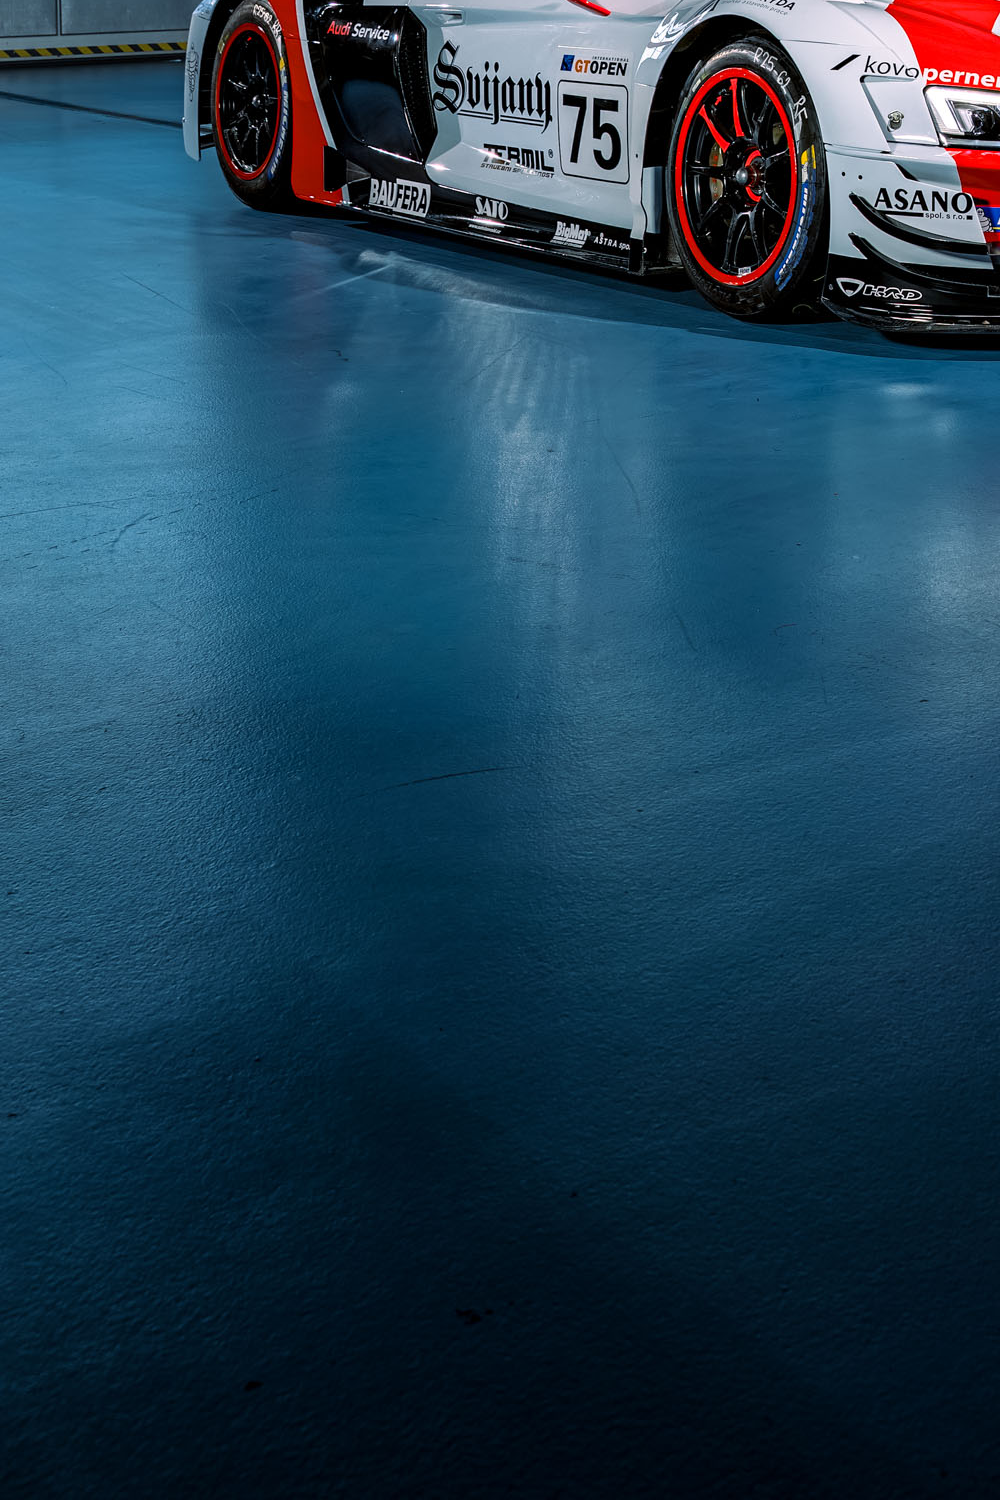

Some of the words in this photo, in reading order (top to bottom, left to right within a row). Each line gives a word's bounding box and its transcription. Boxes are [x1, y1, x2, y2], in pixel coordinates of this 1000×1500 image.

[327, 20, 353, 36] Audi
[352, 23, 390, 41] Service
[753, 47, 791, 95] R25-62
[432, 40, 553, 134] Svijany
[563, 94, 622, 171] 75
[484, 143, 555, 172] TERMIL
[369, 178, 430, 217] BAUFERA
[475, 196, 509, 220] SATO
[874, 187, 974, 214] ASANO
[925, 212, 945, 220] spol.
[555, 221, 588, 241] BigMat
